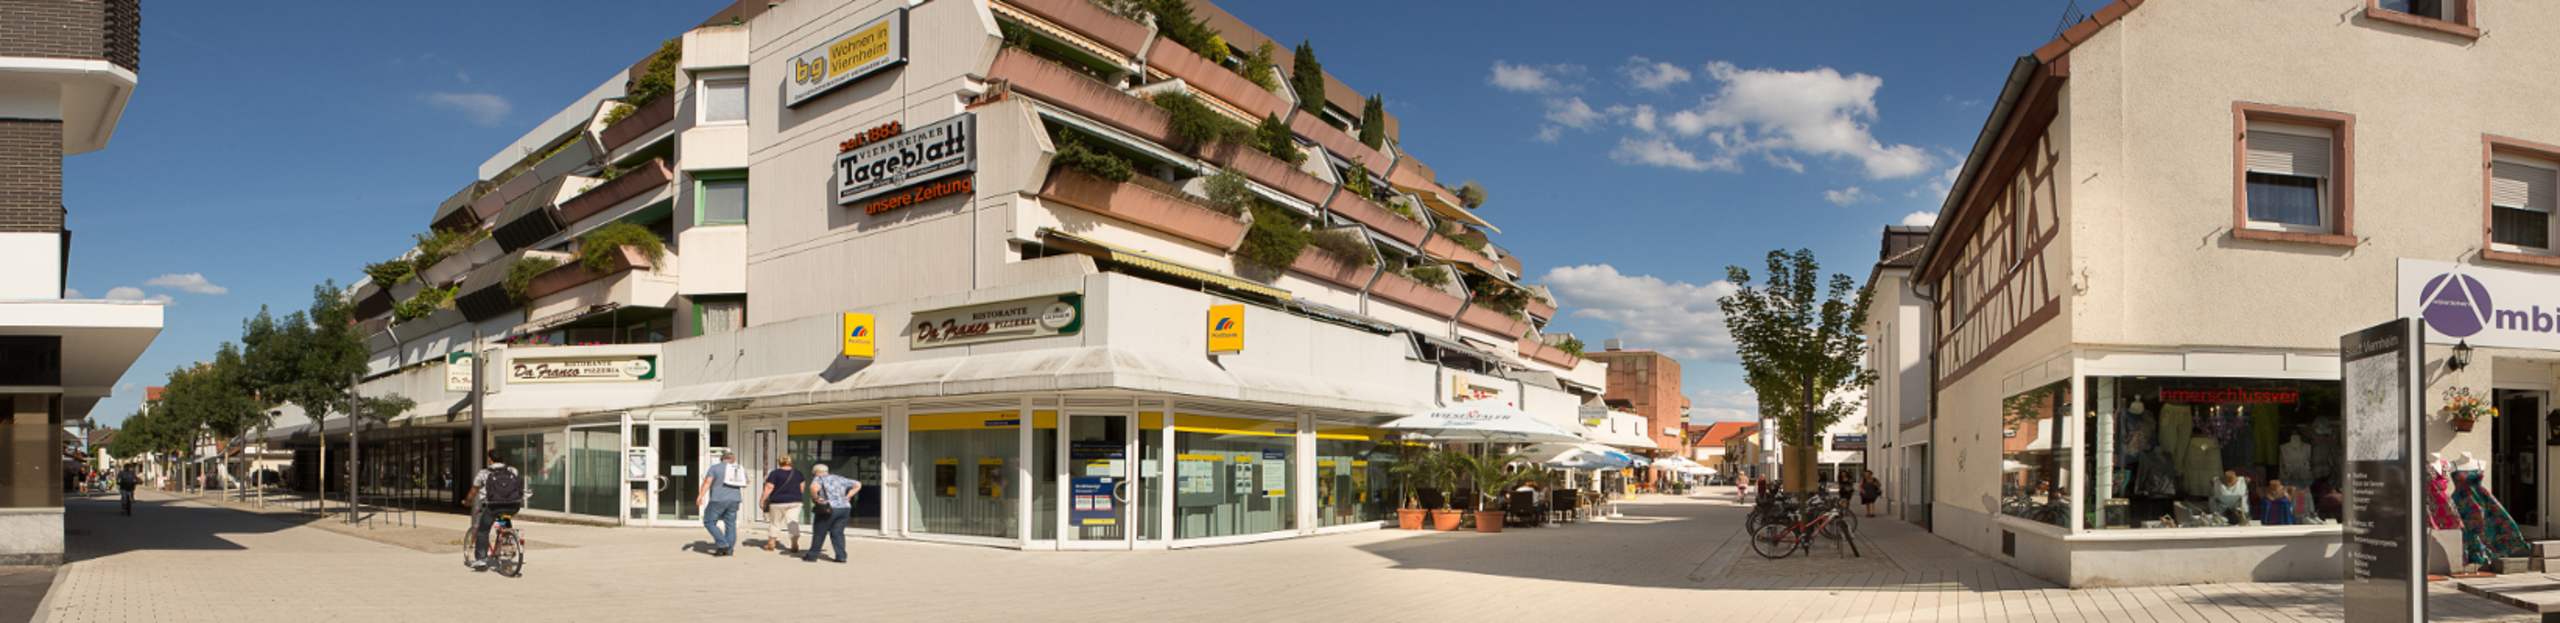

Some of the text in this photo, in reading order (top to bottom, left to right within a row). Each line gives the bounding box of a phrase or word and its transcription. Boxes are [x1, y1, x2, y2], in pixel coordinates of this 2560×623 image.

[831, 27, 887, 59] Wohnen in
[831, 41, 887, 72] Viernheim
[795, 56, 826, 84] bg
[839, 120, 899, 152] seit 1883
[859, 127, 944, 159] VIERNHEIMER
[840, 120, 965, 186] Tageblatt
[865, 193, 911, 215] unsere
[914, 179, 971, 203] Zeitung
[917, 317, 1037, 342] Da Franco PIZZERIA
[972, 307, 1028, 321] RISTORANTE
[2364, 334, 2399, 353] Viernheim
[513, 363, 536, 379] Da
[537, 363, 581, 379] Franco
